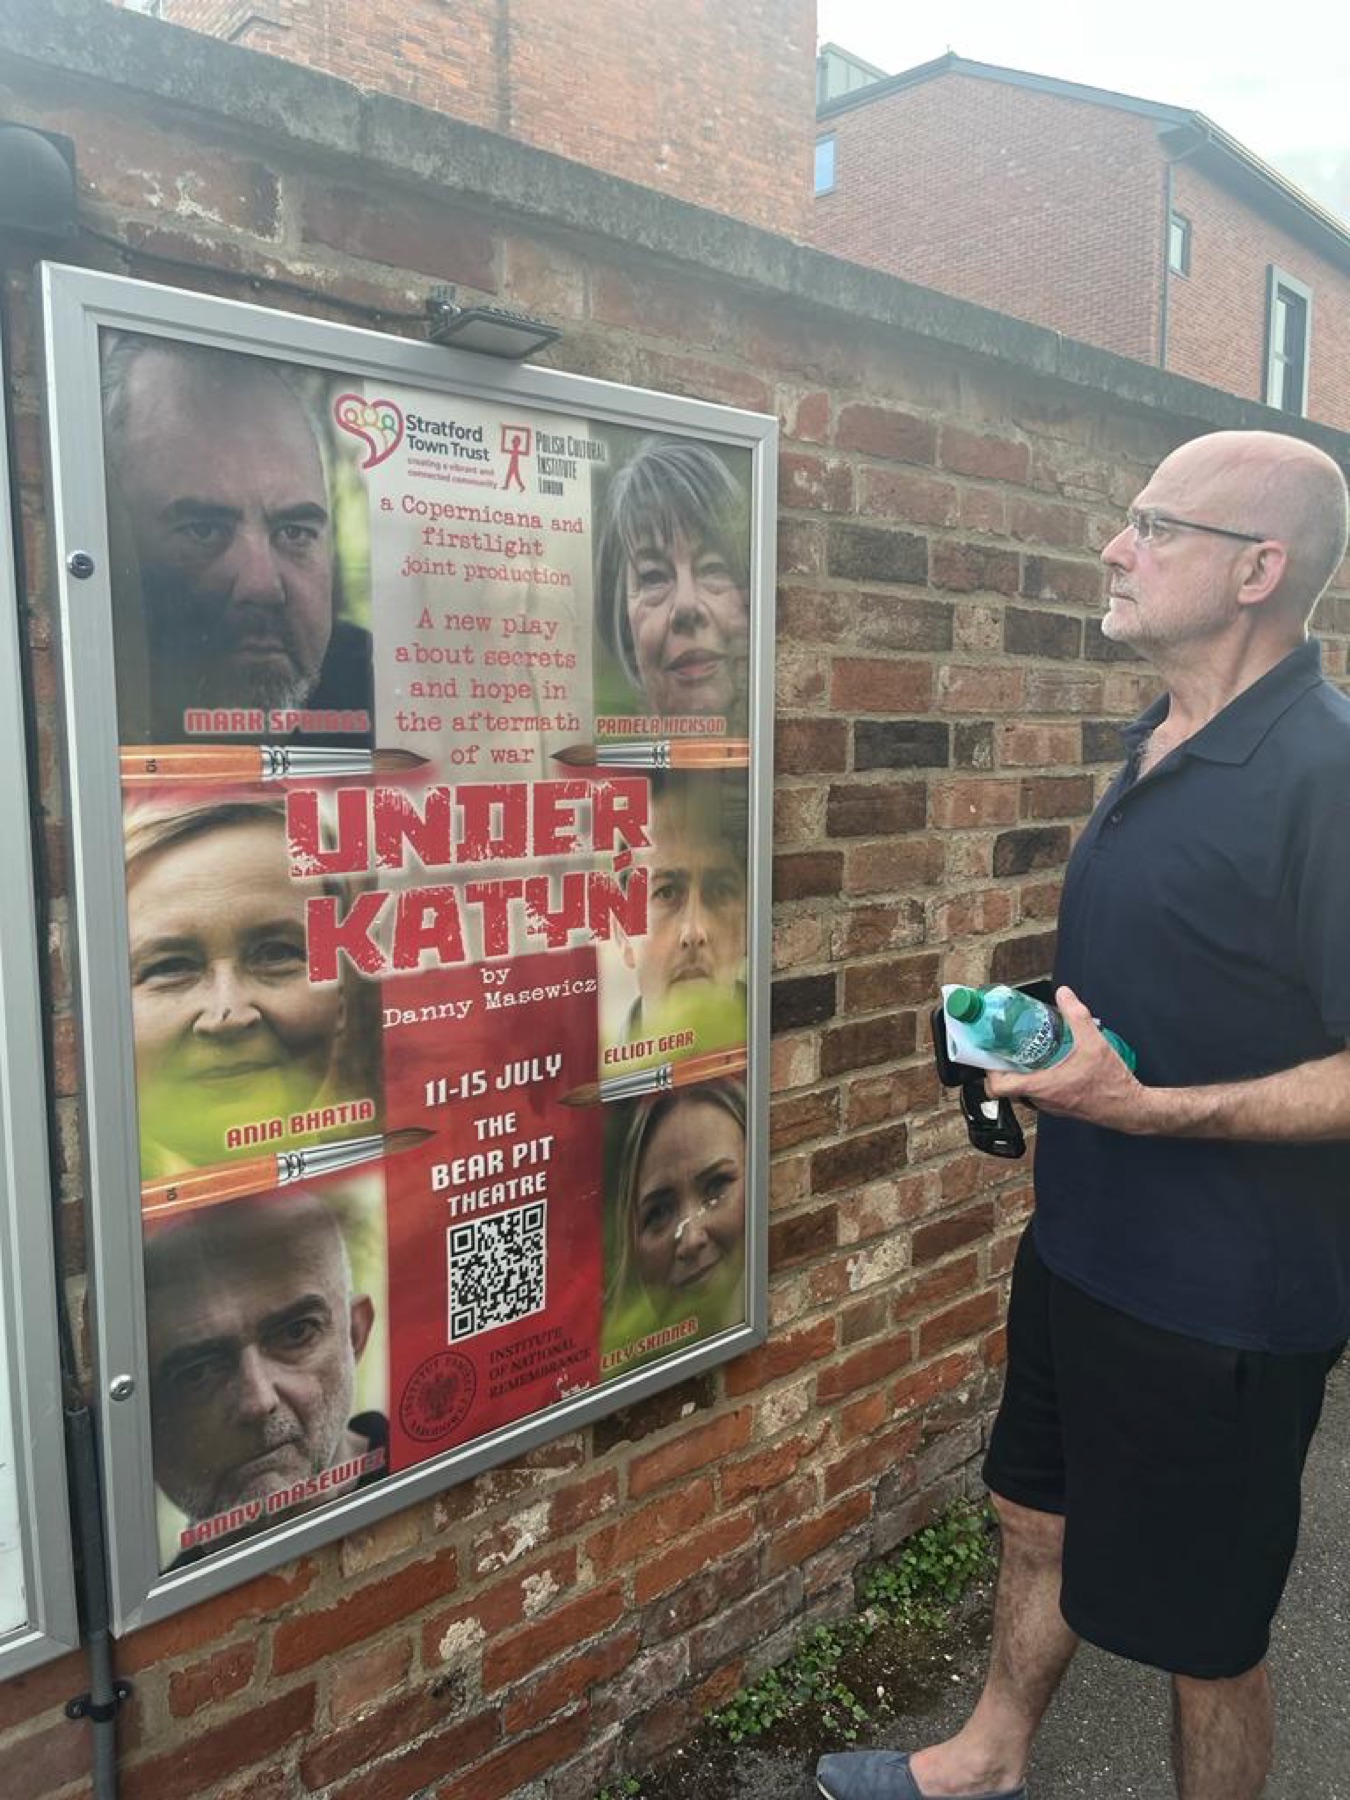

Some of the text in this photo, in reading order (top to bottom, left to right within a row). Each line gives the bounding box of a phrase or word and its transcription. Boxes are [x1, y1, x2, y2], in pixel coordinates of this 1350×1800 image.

[406, 414, 483, 442] Stratford
[407, 435, 490, 462] Town Trust
[381, 495, 584, 534] a Copernicana and
[422, 526, 544, 557] firstlight
[402, 556, 572, 586] joint production
[416, 607, 559, 640] A new play
[395, 643, 577, 669] about secrets
[409, 678, 567, 703] and hope in
[185, 709, 264, 733] MARK
[395, 710, 580, 732] the aftermath
[597, 716, 660, 734] PAMELA
[450, 745, 535, 765] of war
[286, 778, 651, 878] UNDER
[480, 968, 511, 985] by
[382, 979, 597, 1028] Danny Masewicz
[604, 1030, 694, 1065] ELLIOT GEAR
[424, 1053, 563, 1108] 11-15 JULY
[226, 1100, 375, 1150] ANIA BHATIA
[473, 1111, 518, 1142] THE
[431, 1135, 555, 1192] BEAR PIT
[447, 1171, 547, 1218] THEATRE
[489, 1326, 563, 1365] INSTITUTE
[179, 1499, 263, 1549] DANNY
